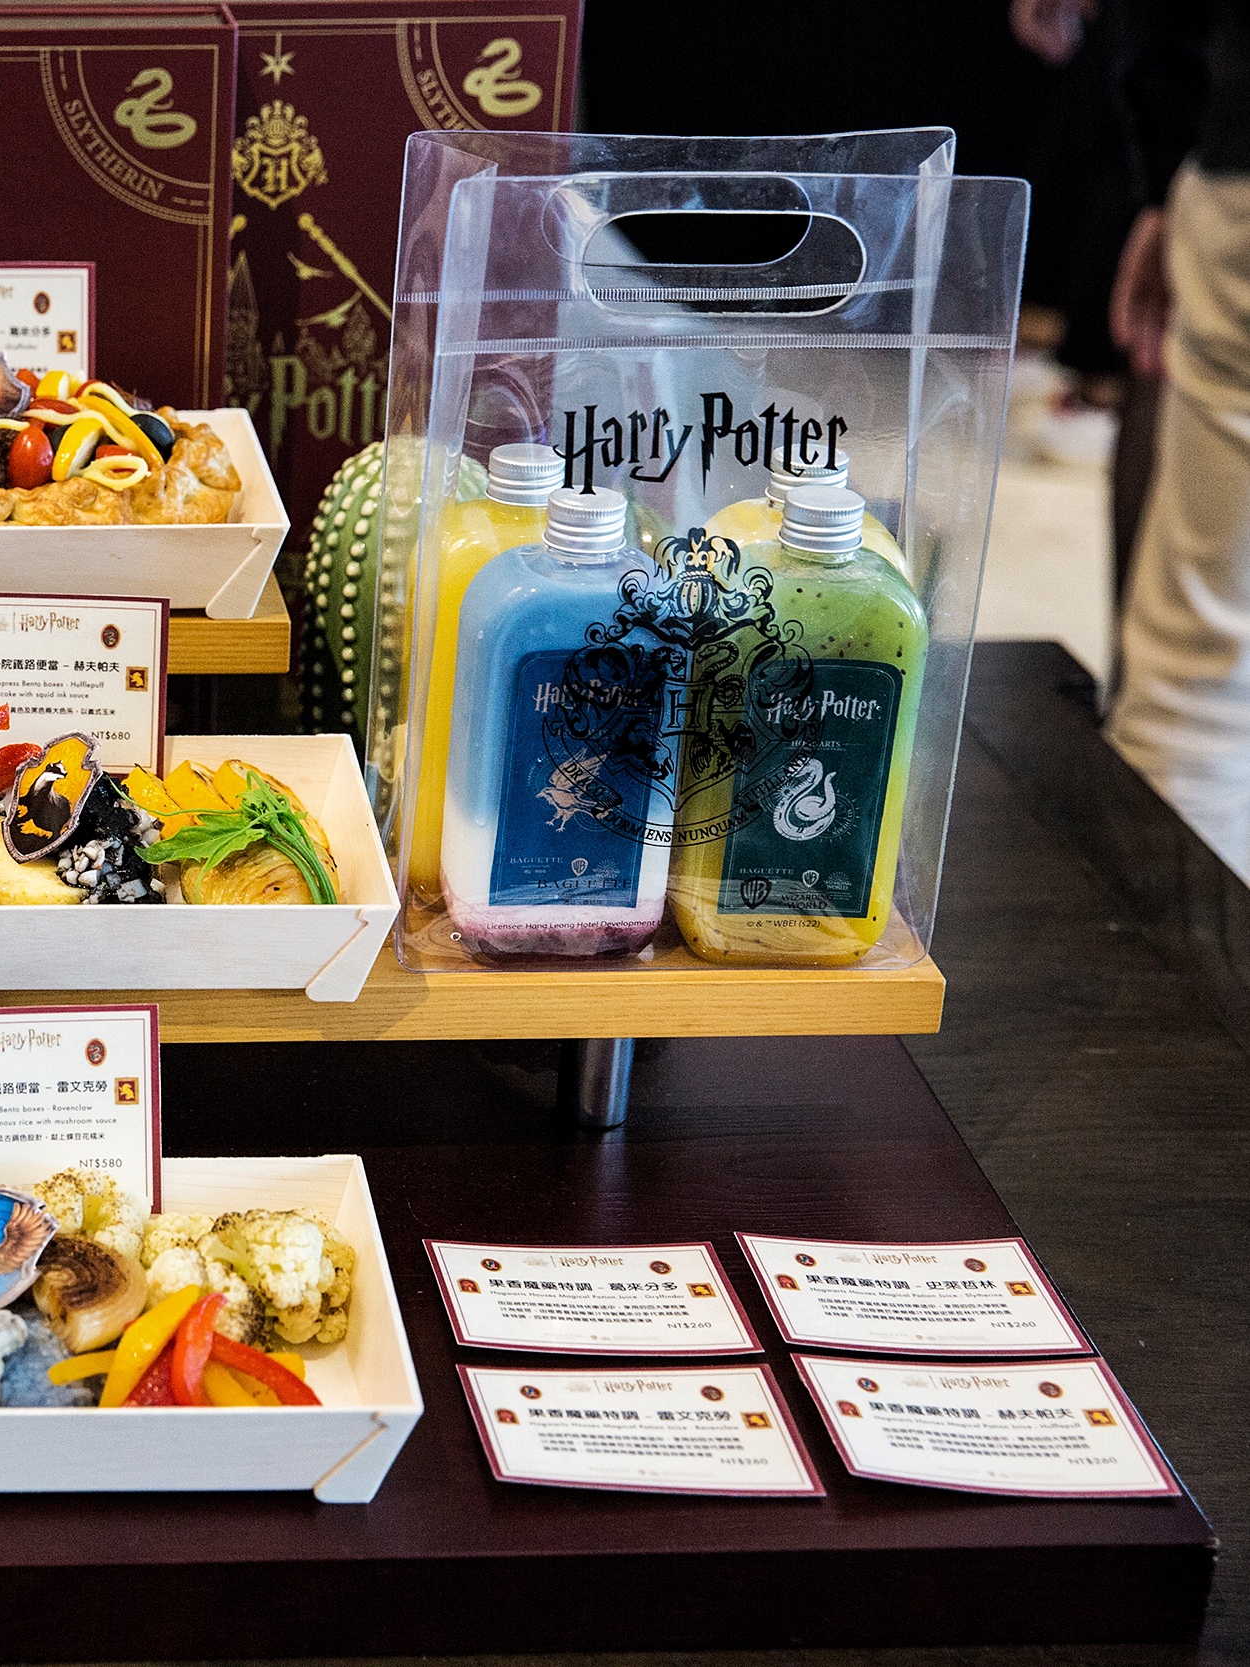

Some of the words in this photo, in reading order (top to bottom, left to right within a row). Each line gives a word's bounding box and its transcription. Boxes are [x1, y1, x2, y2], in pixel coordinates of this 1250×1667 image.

[64, 98, 165, 202] SLYTHERIN
[270, 355, 387, 470] Pott
[553, 405, 693, 495] Harry
[700, 391, 848, 497] Potter
[18, 613, 48, 632] Harry
[49, 612, 81, 633] Potter
[74, 661, 120, 673] 赫夫帕夫
[22, 680, 42, 688] Bento
[43, 680, 64, 688] boxes
[70, 681, 105, 689] Hufflepuff
[35, 691, 54, 699] squid
[820, 690, 877, 721] Potter
[91, 731, 131, 741] NT$680
[605, 812, 672, 843] DORMIENS
[677, 811, 748, 842] NUNQUAM
[787, 901, 828, 910] WORLD
[600, 920, 655, 929] Development
[28, 1028, 62, 1053] Potter
[56, 1080, 108, 1094] 雷文克勞
[22, 1105, 45, 1113] boxes
[52, 1104, 93, 1112] Ravenclaw
[18, 1119, 34, 1127] rice
[35, 1118, 52, 1126] with
[54, 1117, 92, 1126] mushroom
[95, 1117, 118, 1125] sauce
[79, 1158, 123, 1169] NT$580
[488, 1279, 593, 1292] 果香魔藥特調
[609, 1282, 679, 1292] 葛來分多
[805, 1274, 910, 1290] 果香魔藥特調
[926, 1279, 997, 1290] 史萊哲林
[667, 1321, 712, 1329] NT$260
